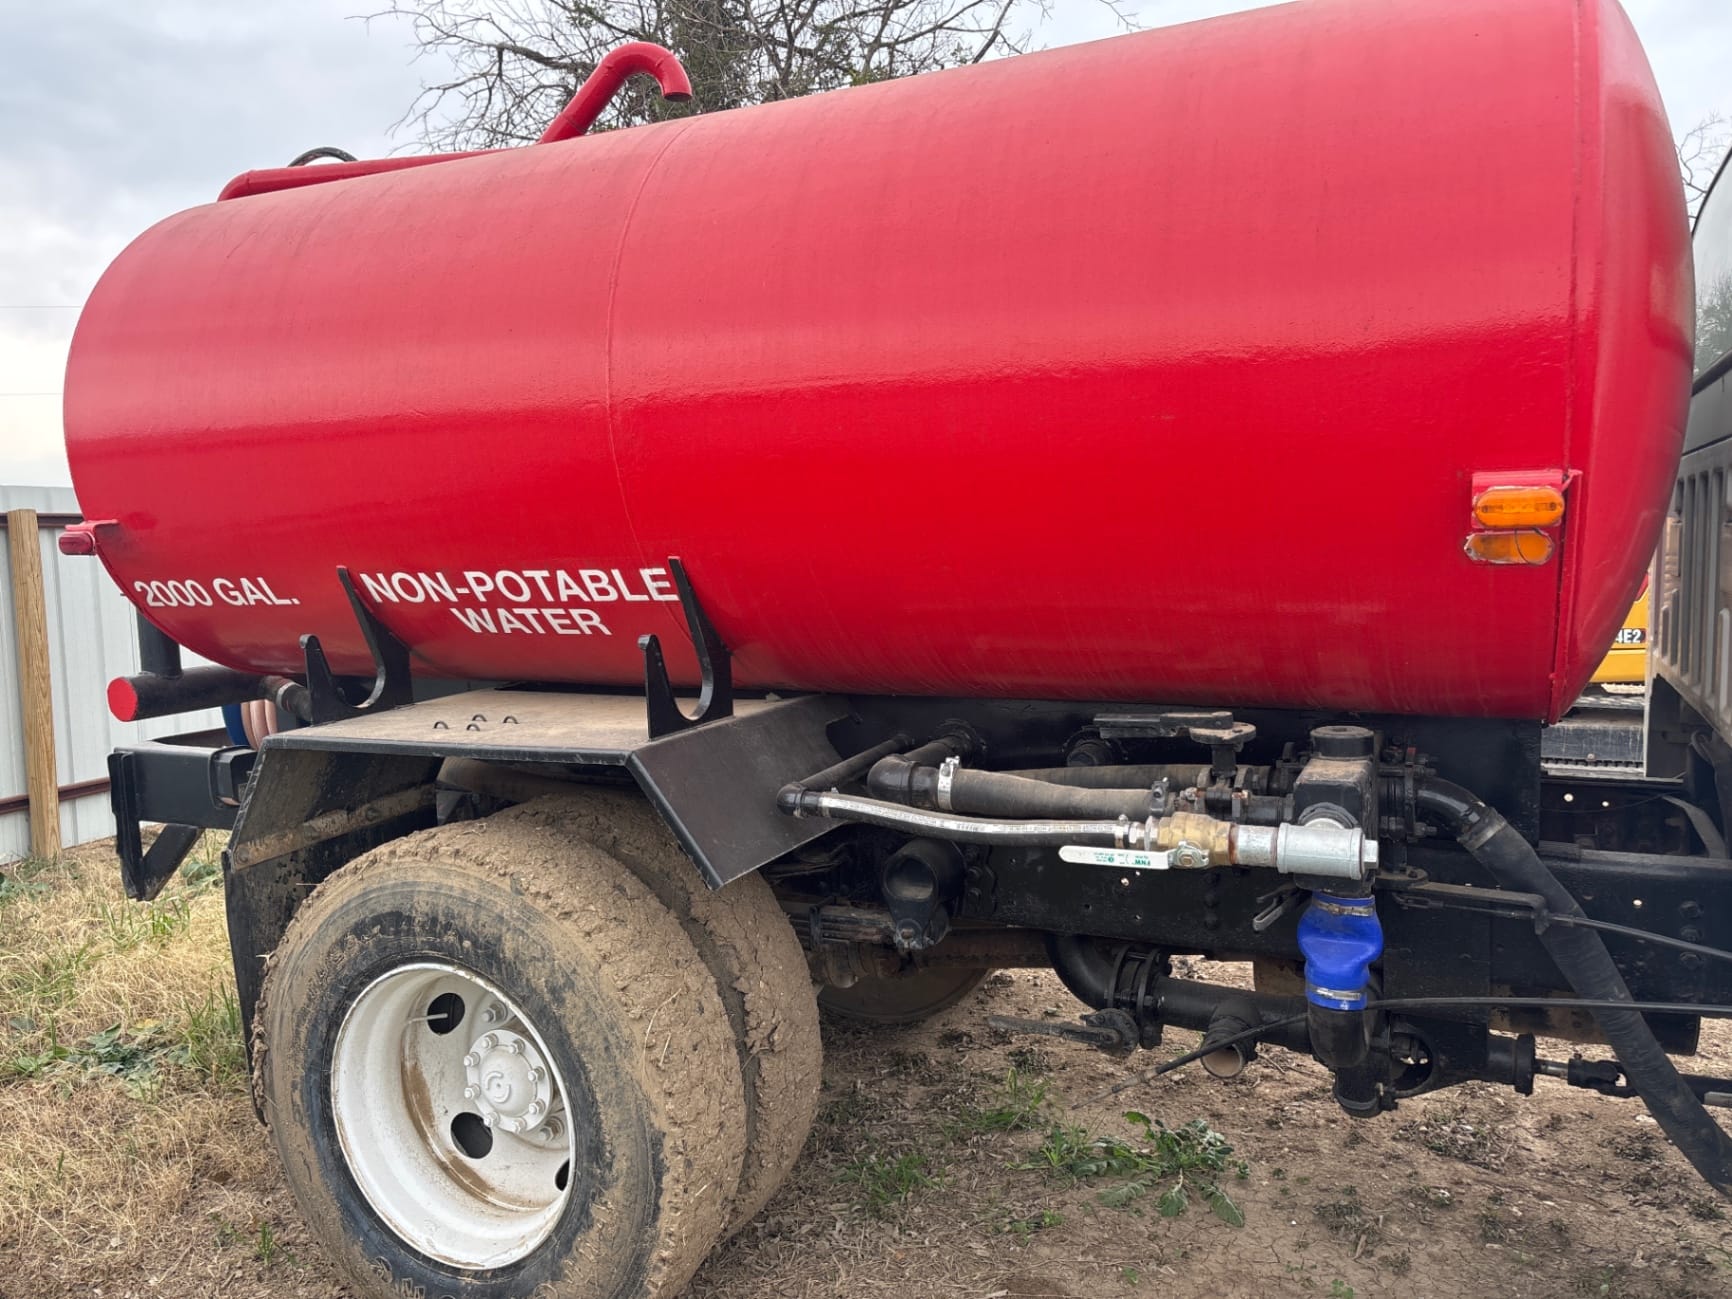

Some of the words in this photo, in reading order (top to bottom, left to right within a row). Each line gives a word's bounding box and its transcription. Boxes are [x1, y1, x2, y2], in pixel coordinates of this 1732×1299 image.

[134, 580, 213, 607] 2000
[213, 577, 300, 606] GAL.
[359, 568, 680, 603] NON-POTABLE
[449, 607, 612, 635] WATER
